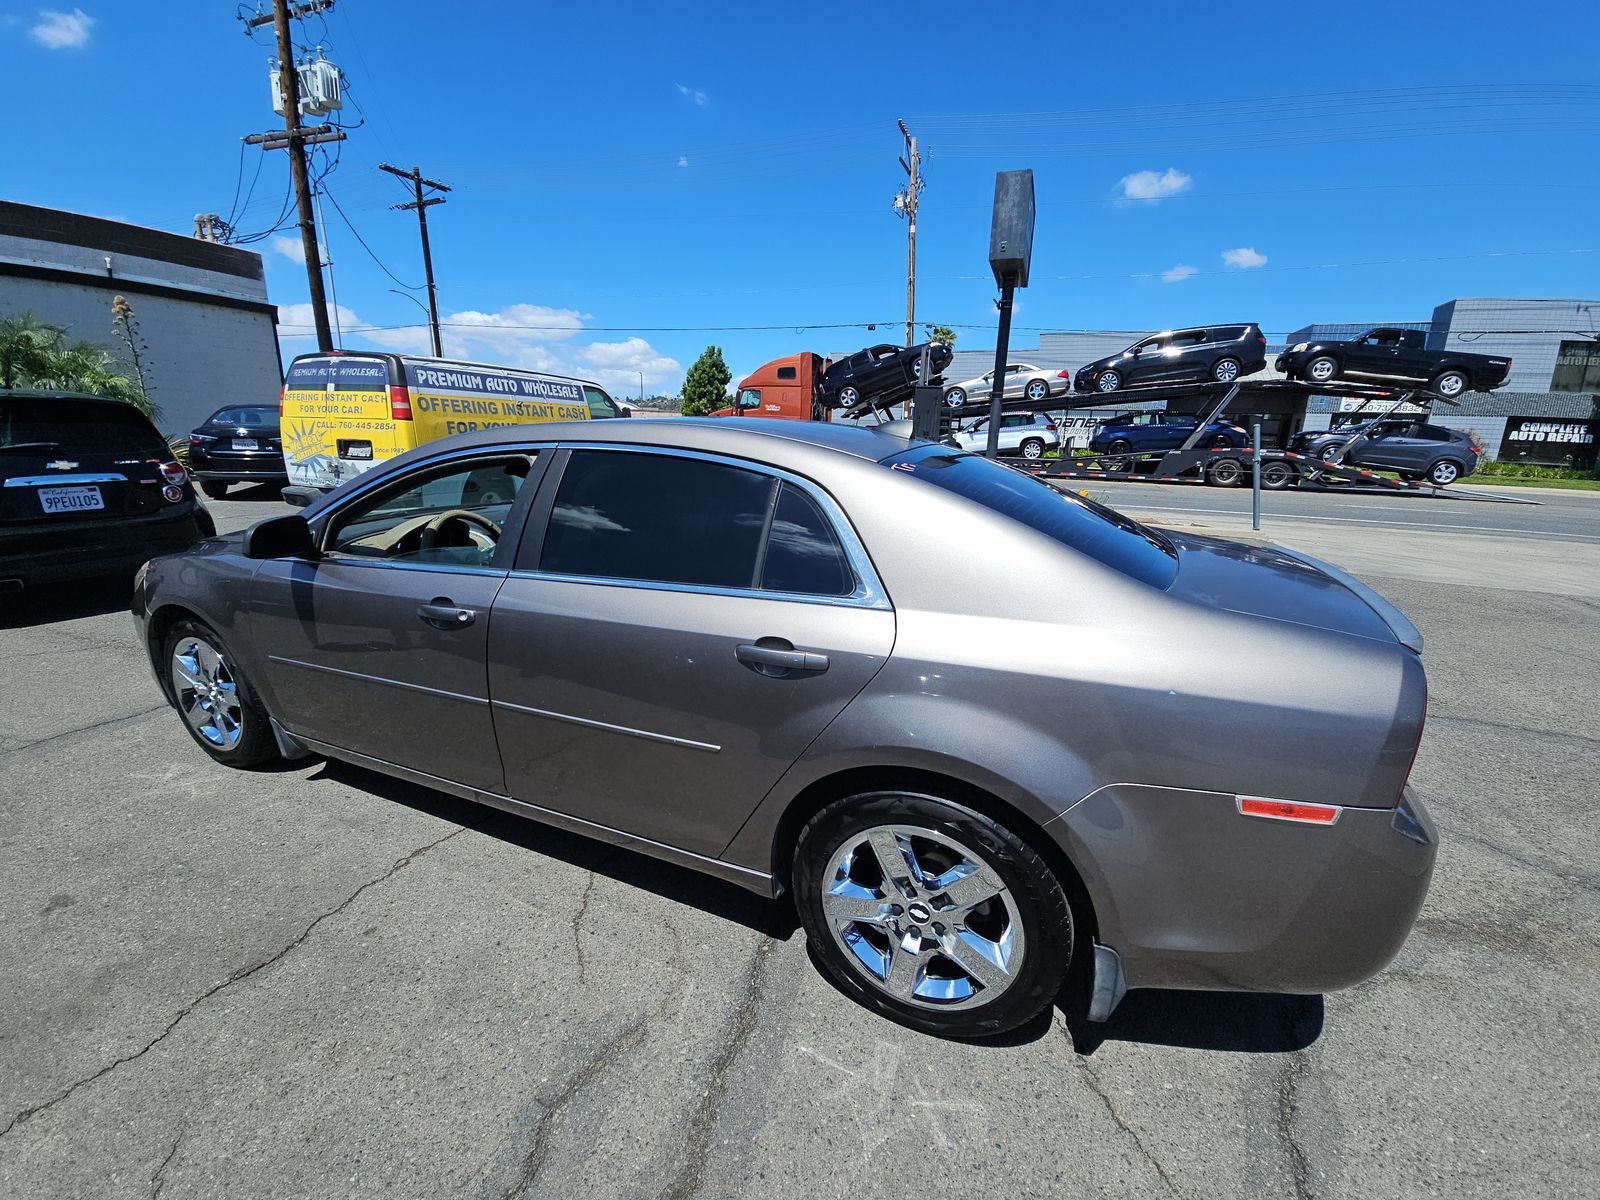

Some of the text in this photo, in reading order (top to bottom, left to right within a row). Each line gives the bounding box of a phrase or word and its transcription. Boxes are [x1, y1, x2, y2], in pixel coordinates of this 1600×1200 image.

[416, 369, 579, 398] PREMIUM AUTO WHOLESALE
[322, 394, 358, 402] INSTANT
[361, 395, 388, 403] CASH
[316, 405, 339, 413] YOUR
[341, 406, 363, 414] CAR!
[417, 397, 586, 420] OFFERING INSTANT CASH
[316, 421, 396, 430] CALL: 760-445-2854
[446, 421, 478, 435] FOR
[1520, 422, 1588, 434] COMPLETE
[1508, 430, 1594, 444] AUTO REPAIR
[45, 494, 100, 509] 9PEU105
